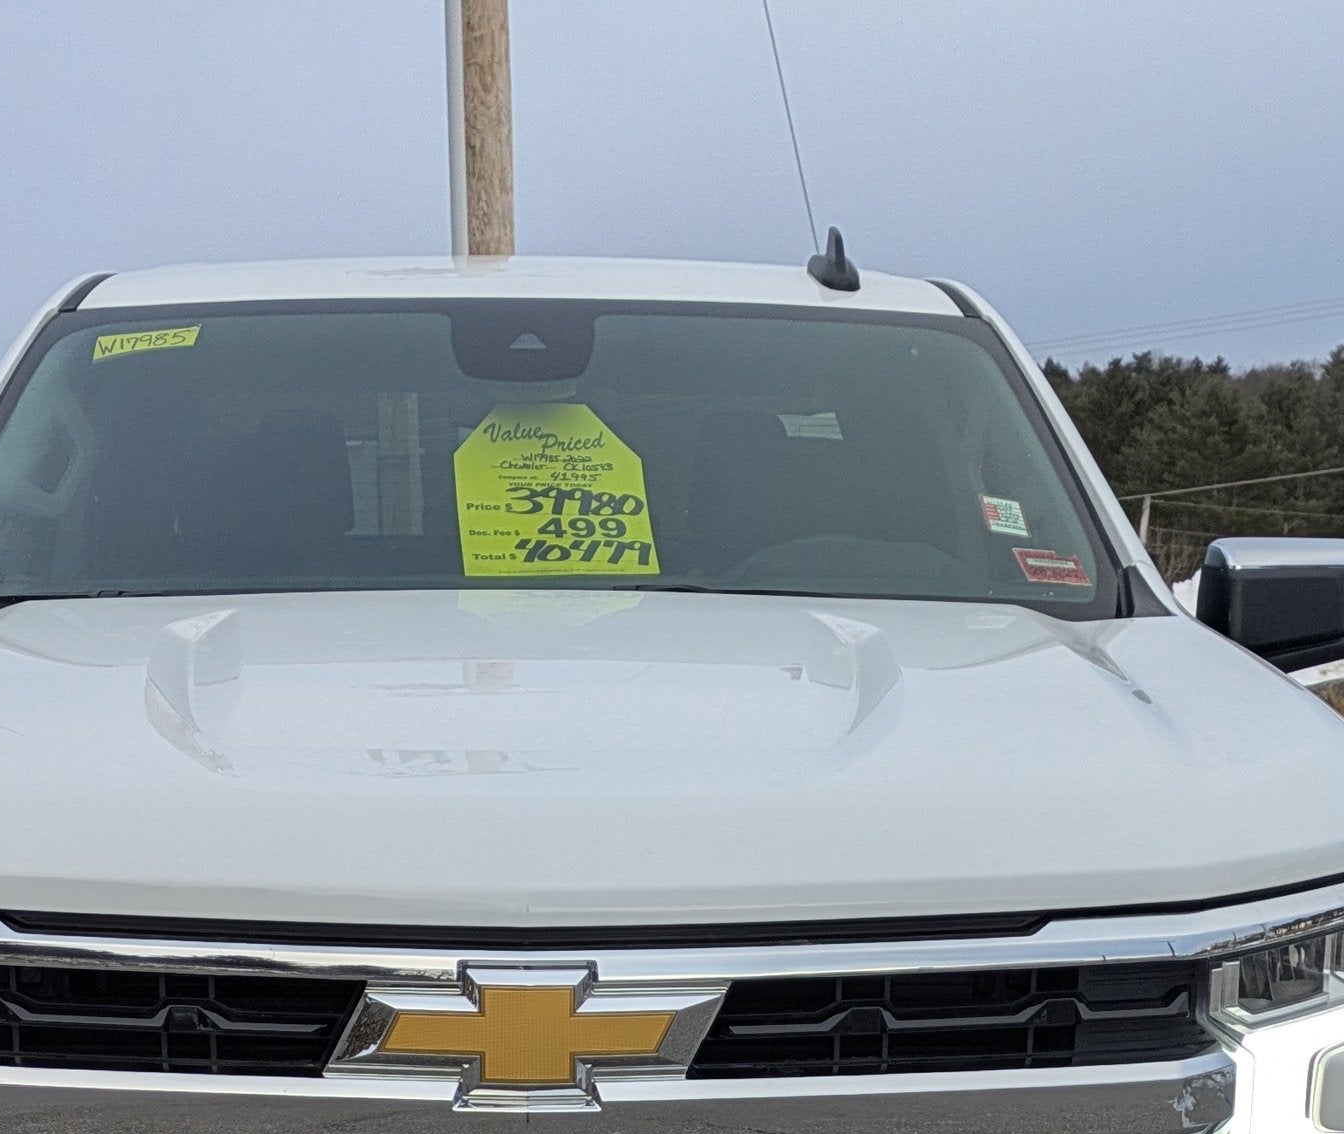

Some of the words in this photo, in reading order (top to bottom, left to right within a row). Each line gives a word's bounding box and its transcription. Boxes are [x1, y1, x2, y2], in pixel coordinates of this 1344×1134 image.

[98, 329, 192, 355] W17985
[483, 422, 543, 442] Value
[539, 431, 605, 454] Priced
[550, 471, 602, 481] 41995
[466, 503, 501, 511] Price
[506, 487, 644, 516] 39980
[537, 518, 627, 539] 499
[514, 538, 652, 566] 40479
